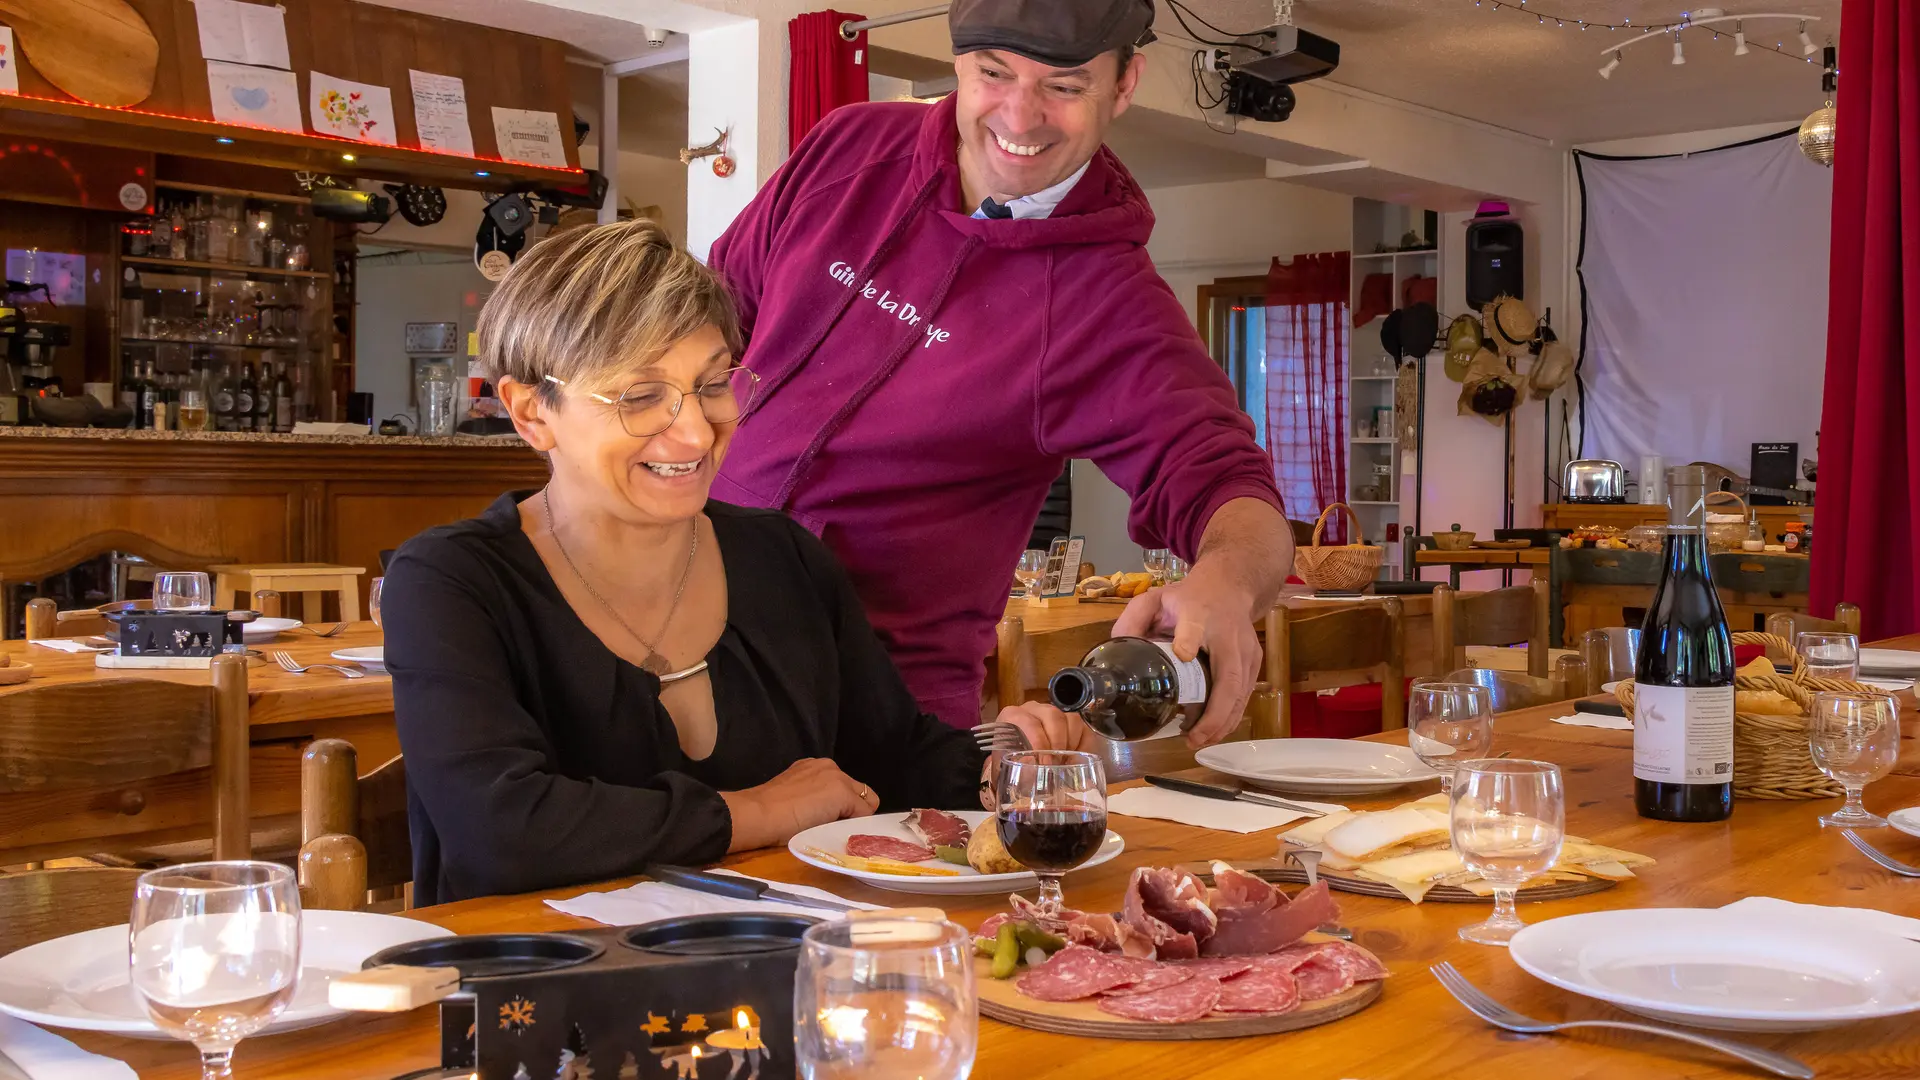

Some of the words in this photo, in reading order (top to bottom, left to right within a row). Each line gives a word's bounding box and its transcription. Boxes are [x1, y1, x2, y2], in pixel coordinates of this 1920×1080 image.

[829, 261, 855, 288] Git
[876, 290, 899, 314] la
[898, 303, 951, 348] Drye
